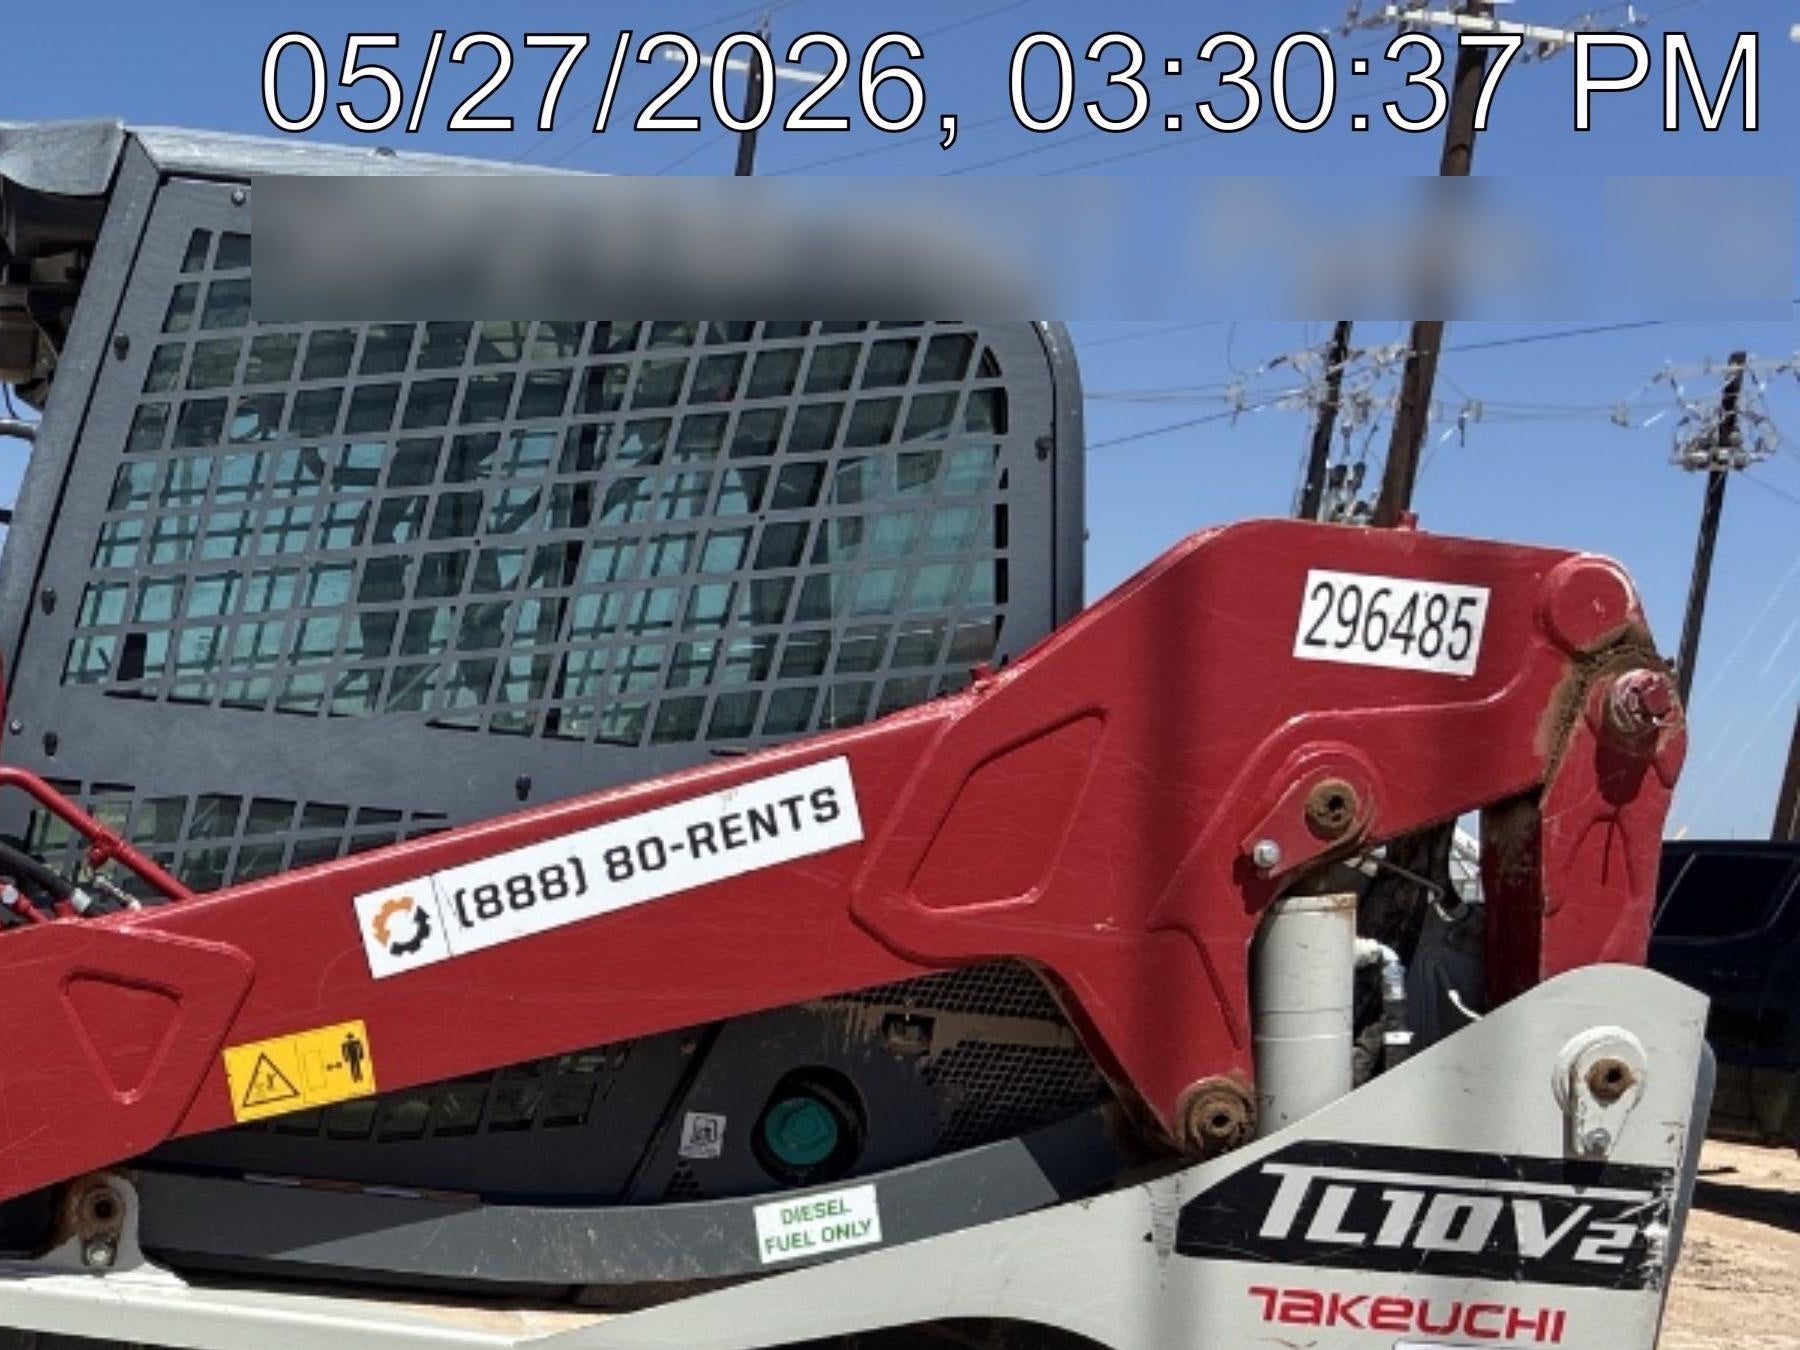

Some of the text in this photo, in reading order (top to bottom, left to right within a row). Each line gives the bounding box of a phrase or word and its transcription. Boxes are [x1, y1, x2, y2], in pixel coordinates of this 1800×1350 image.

[1303, 581, 1478, 661] 296485
[454, 786, 841, 928] (888) 80-RENTS
[764, 1217, 872, 1255] FUEL ONLY
[781, 1198, 852, 1225] DIESEL
